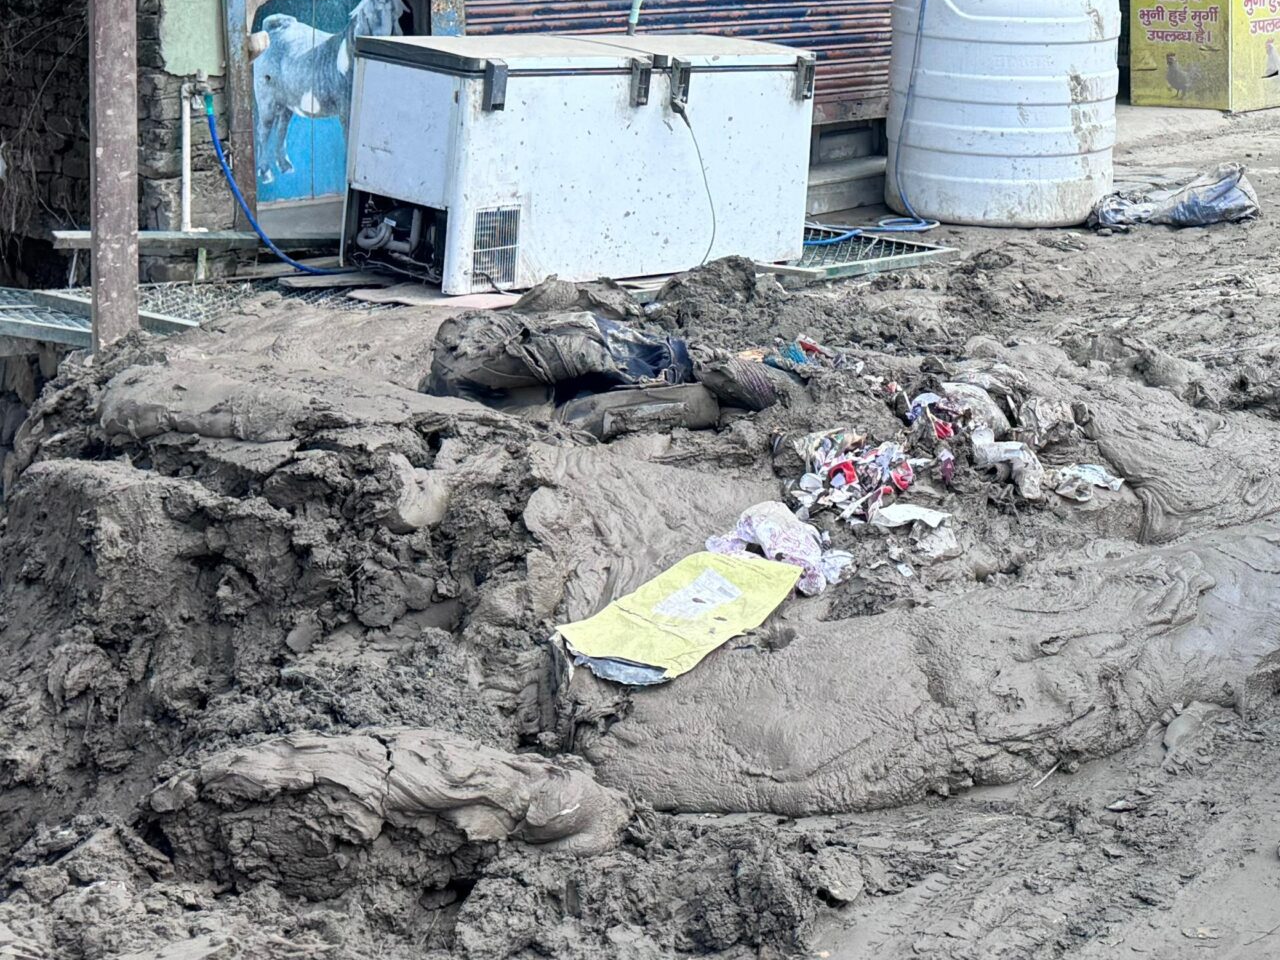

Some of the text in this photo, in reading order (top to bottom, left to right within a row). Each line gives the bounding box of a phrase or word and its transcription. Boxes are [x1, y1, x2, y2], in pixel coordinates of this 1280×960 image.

[1139, 6, 1219, 28] भुनी हुई मुर्गी
